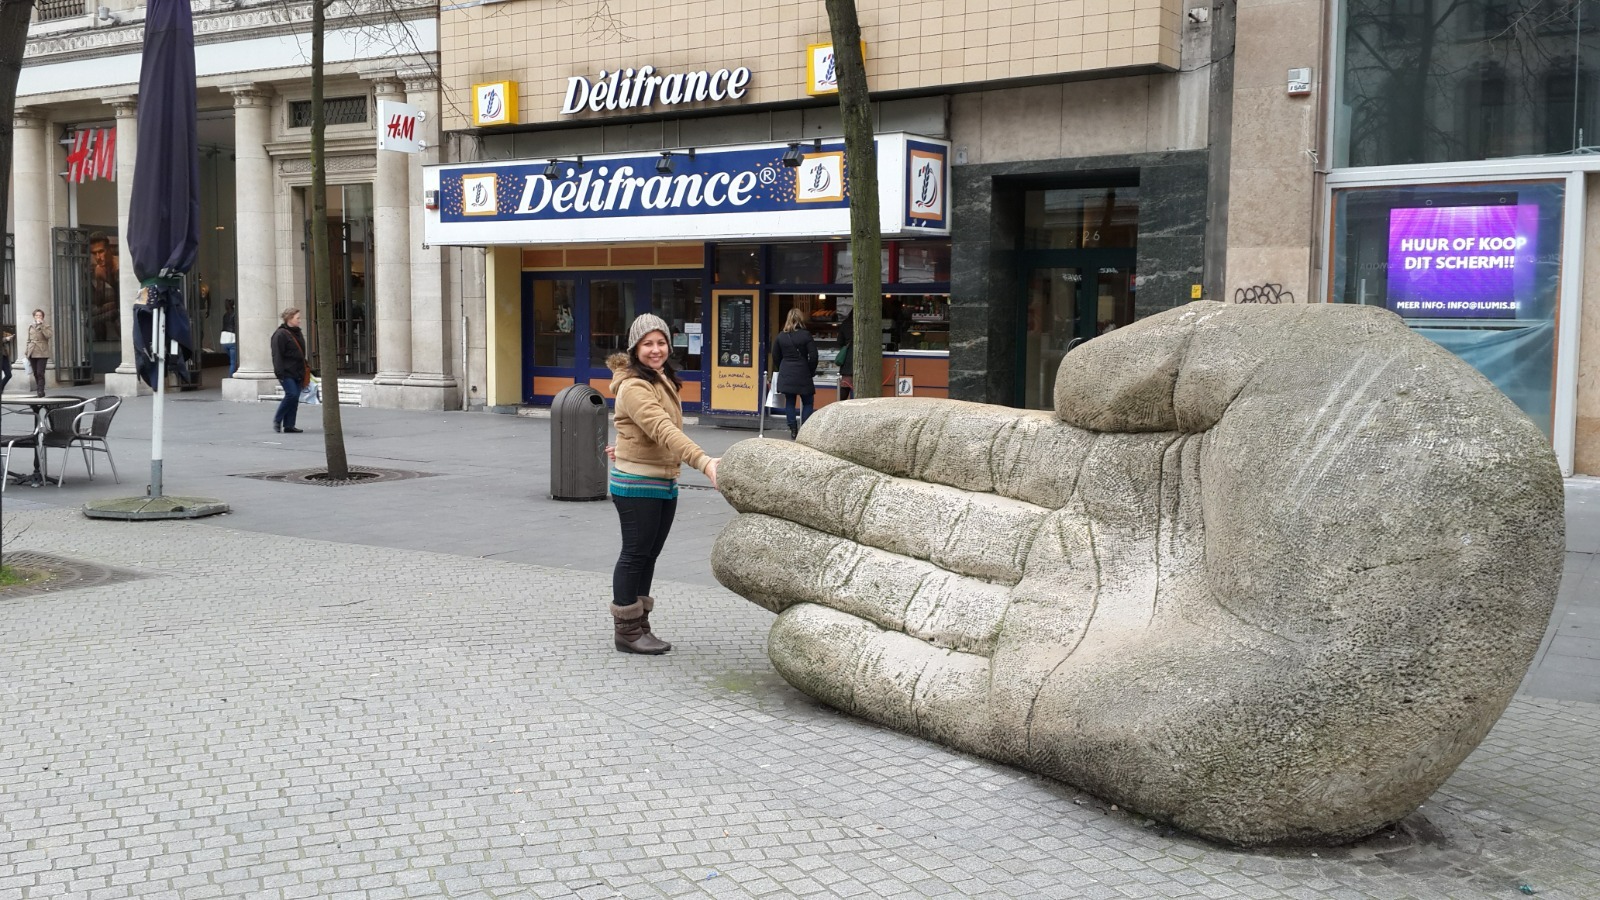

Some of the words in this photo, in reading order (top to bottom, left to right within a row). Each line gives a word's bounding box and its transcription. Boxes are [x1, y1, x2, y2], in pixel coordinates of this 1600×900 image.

[560, 65, 751, 115] Délifrance
[387, 113, 416, 142] H&M
[66, 126, 117, 184] H&M
[1083, 230, 1101, 241] 26
[1401, 237, 1449, 252] HUUR
[1452, 237, 1475, 251] OF
[1479, 236, 1527, 251] KOOP
[1404, 256, 1433, 270] DIT
[1435, 255, 1515, 269] SCHERM!!
[1396, 301, 1420, 309] MEER
[1422, 301, 1446, 309] INFO:
